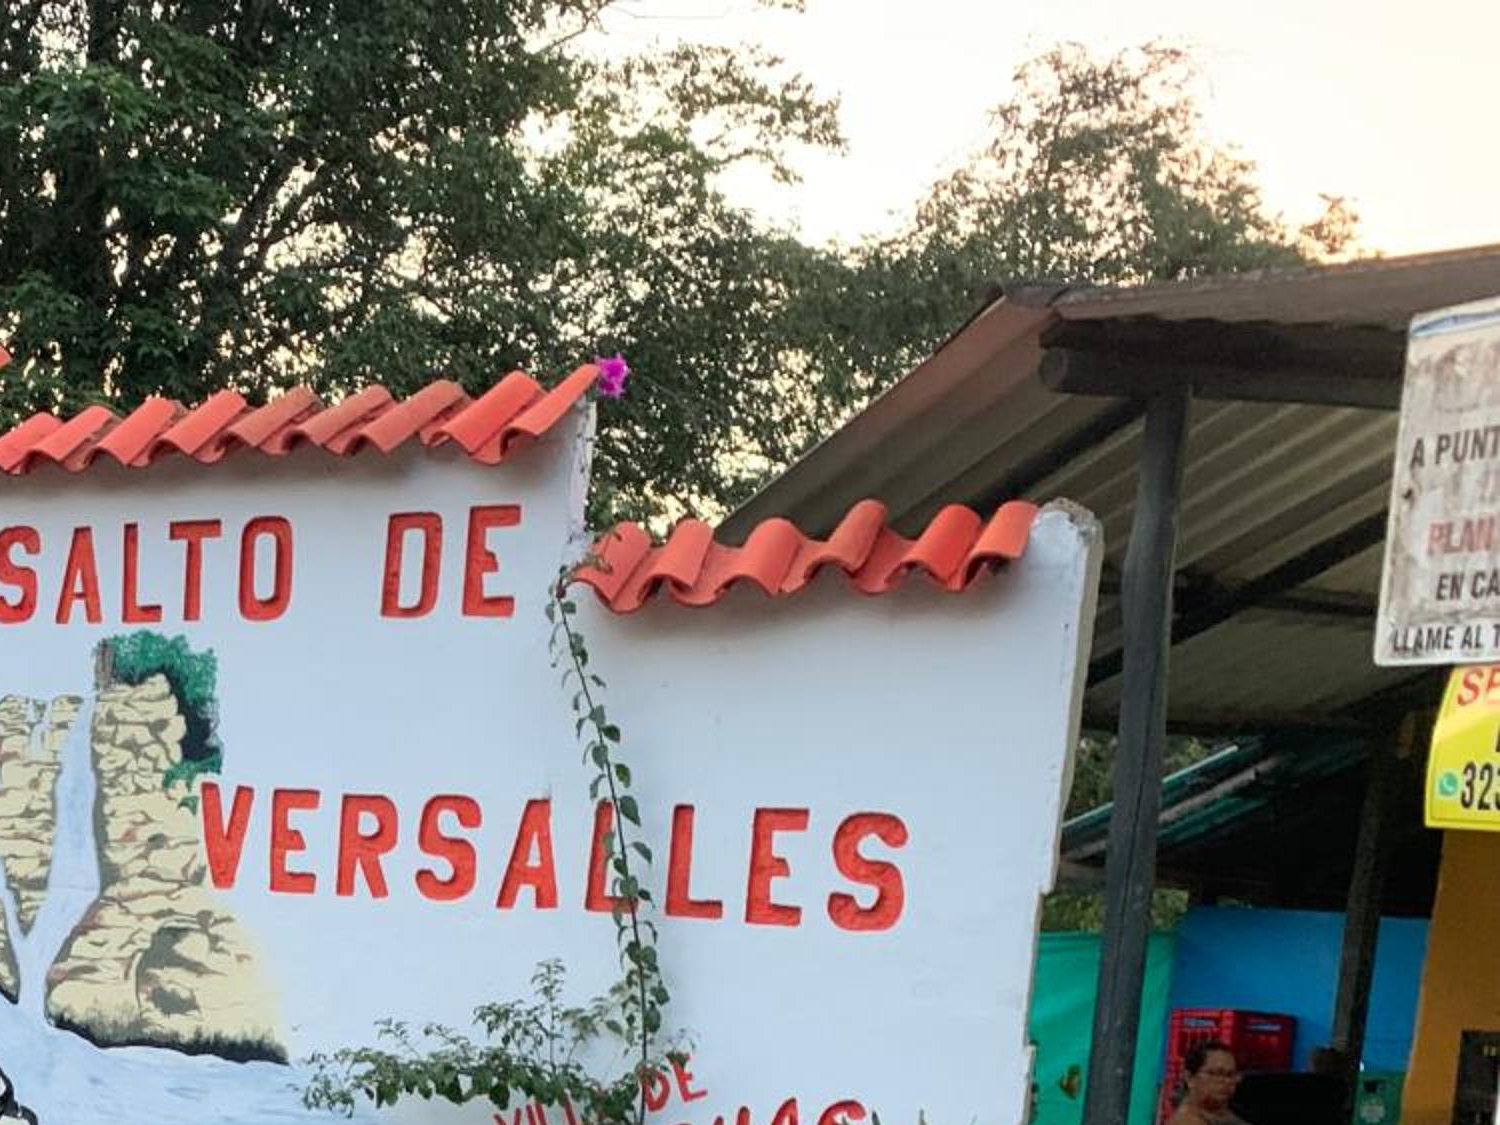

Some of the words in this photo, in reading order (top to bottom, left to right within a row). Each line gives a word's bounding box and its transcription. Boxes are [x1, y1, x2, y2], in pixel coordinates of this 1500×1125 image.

[1410, 437, 1425, 469] A
[1434, 425, 1500, 465] PUNT
[381, 504, 522, 619] DE
[1436, 573, 1465, 601] EN
[1392, 626, 1455, 656] LLAME
[1460, 624, 1482, 649] AL
[201, 782, 910, 932] VERSALLES
[638, 1052, 710, 1113] DE
